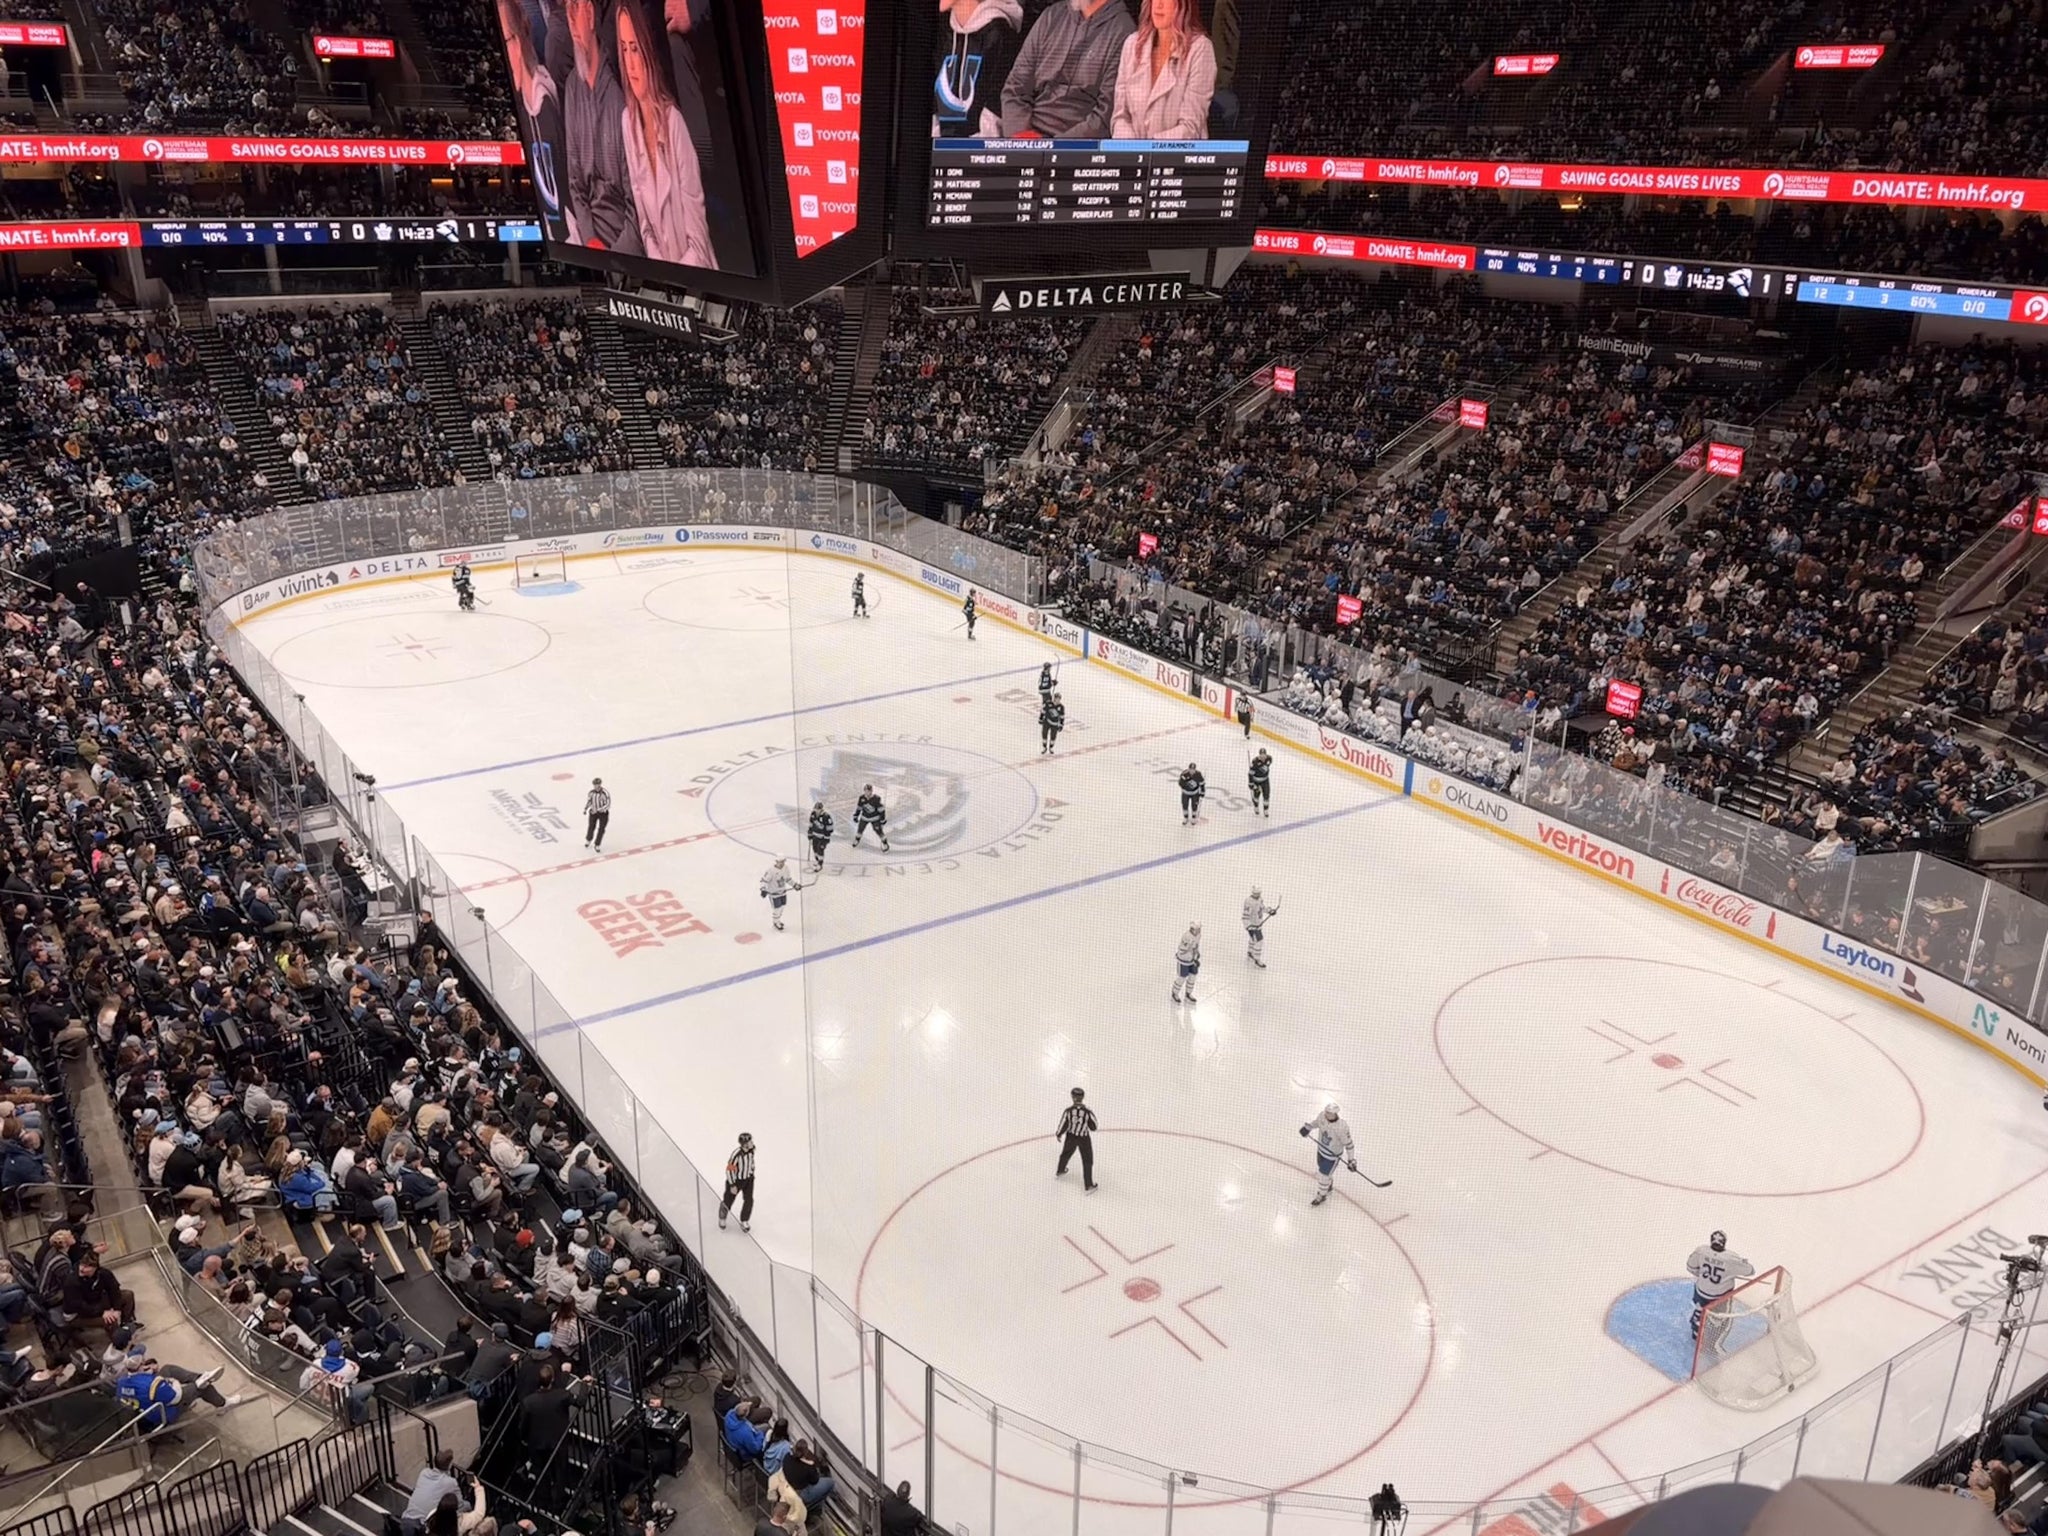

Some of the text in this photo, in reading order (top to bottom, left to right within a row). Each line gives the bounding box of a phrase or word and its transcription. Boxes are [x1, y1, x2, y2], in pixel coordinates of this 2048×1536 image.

[811, 54, 856, 67] TOYOTA
[816, 129, 860, 141] TOYOTA
[43, 141, 120, 160] hmhf.org
[163, 140, 208, 148] HUNTSMAN
[984, 140, 1054, 149] TORONTO MAPLE LEAFS
[231, 143, 427, 159] SAVING GOALS SAVES LIVES
[970, 155, 1007, 163] TIME ON ICE
[1091, 155, 1106, 163] HITS
[1184, 155, 1198, 163] TIME
[1207, 155, 1216, 163] ICE
[935, 168, 944, 176] 11
[1074, 169, 1120, 177] BLOCKED SHOTS
[1280, 161, 1307, 173] LIVES
[1378, 164, 1426, 179] DONATE:
[1428, 165, 1479, 185] hmhf.org
[1560, 171, 1606, 186] SAVING
[1609, 172, 1654, 188] GOALS
[1656, 174, 1699, 189] SAVES
[1702, 175, 1741, 191] LIVES
[1785, 175, 1830, 184] HUNTSMAN
[946, 180, 981, 189] MATTHEWS
[1072, 182, 1119, 191] SHOT ATTEMPTS
[1078, 196, 1103, 204] FACEOFF
[1852, 180, 1933, 199] DONATE:
[1937, 183, 2024, 208] hmhf.org
[1072, 210, 1113, 219] POWER PLAYS
[247, 232, 254, 242] 3
[277, 232, 284, 241] 2
[304, 231, 312, 241] 6
[332, 230, 339, 240] 0
[352, 224, 365, 240] 0
[399, 227, 434, 240] 14:23
[467, 223, 475, 238] 1
[488, 230, 495, 238] 5
[512, 229, 522, 238] 12
[53, 230, 129, 246] hmhf.org
[161, 232, 182, 243] 0/0
[203, 233, 227, 242] 40%
[1271, 236, 1299, 249] LIVES
[1369, 243, 1415, 259] DONATE:
[1417, 250, 1467, 268] hmhf.org
[1488, 258, 1503, 270] 0/0
[1517, 261, 1536, 274] 40%
[1551, 265, 1558, 275] 3
[1575, 266, 1582, 278] 2
[1598, 269, 1605, 280] 6
[1623, 269, 1631, 280] 0
[1642, 264, 1655, 283] 0
[1687, 273, 1725, 290] 14:23
[1763, 274, 1771, 293] 1
[1809, 275, 1836, 284] SHOT ATT
[1846, 278, 1860, 286] HITS
[1879, 281, 1895, 289] BLKS
[1785, 283, 1793, 295] 5
[1814, 287, 1827, 299] 12
[1911, 283, 1942, 293] FACEOFFS
[1957, 287, 1997, 298] POWER PLAY
[1018, 282, 1183, 308] DELTA CENTER
[1846, 289, 1854, 301] 3
[1880, 293, 1889, 305] 3
[1910, 295, 1937, 309] 60%
[1963, 300, 1985, 314] 0/0
[616, 300, 692, 333] DELTA CENTER
[1578, 335, 1653, 359] HealthEquity
[1716, 356, 1744, 366] AMERICA
[1743, 360, 1763, 368] FIRST
[692, 531, 748, 541] 1Password
[753, 532, 781, 541] ESPN
[826, 538, 858, 552] moxie
[367, 556, 428, 576] DELTA
[278, 573, 324, 598] vivint
[922, 569, 961, 593] BUD LIGHT
[977, 591, 1018, 620] Trucordia
[1055, 624, 1079, 645] Garff
[692, 732, 933, 784] DELTA CENTER
[1339, 737, 1394, 779] Smith's
[1445, 785, 1509, 823] OKLAND
[487, 788, 531, 822] AMERICA
[521, 820, 559, 844] FIRST
[978, 811, 1064, 860] DELTA
[1537, 821, 1635, 879] verizon
[1677, 878, 1757, 927] Coca-Cola
[625, 888, 714, 940] SEAT
[576, 898, 665, 960] GEEK
[1822, 933, 1895, 978] Layton
[2006, 1027, 2047, 1065] Nomi
[1899, 1225, 2022, 1294] BANK
[1702, 1263, 1725, 1284] 25
